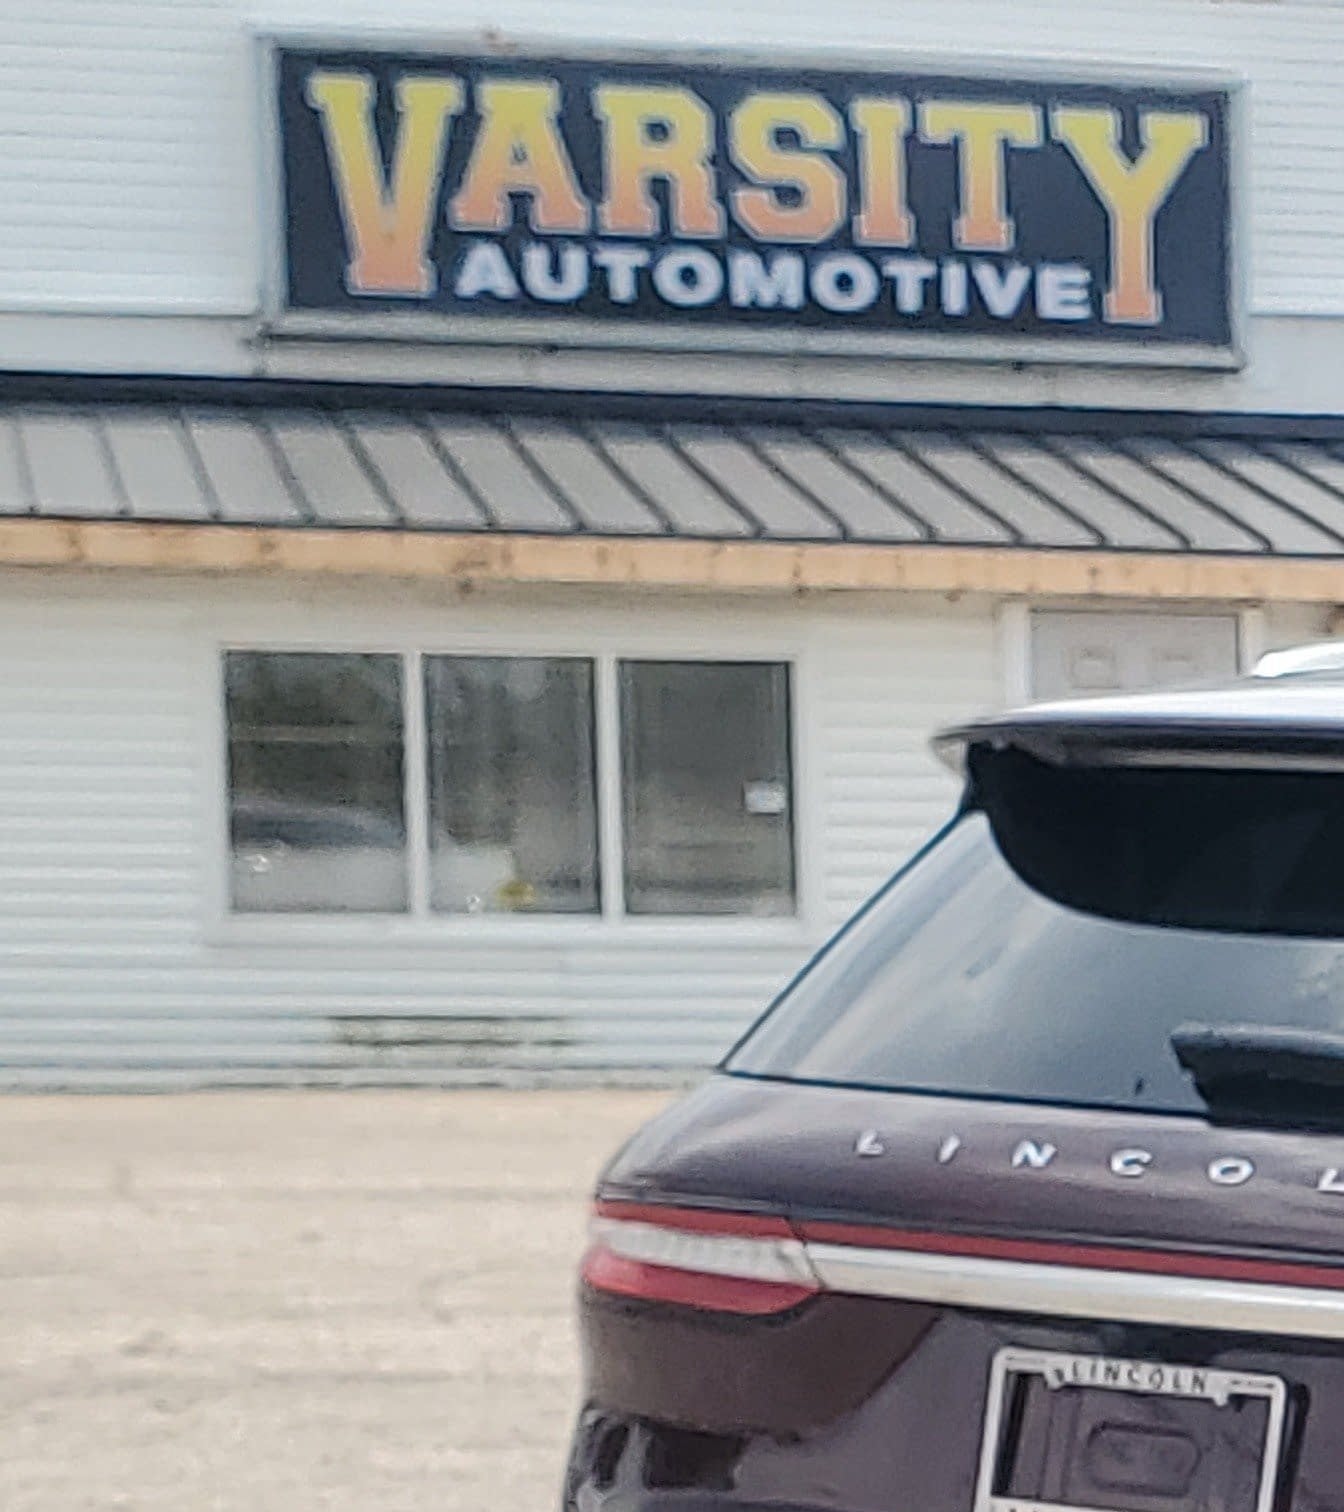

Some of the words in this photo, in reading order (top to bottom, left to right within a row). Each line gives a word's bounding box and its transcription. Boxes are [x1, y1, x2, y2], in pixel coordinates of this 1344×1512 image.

[305, 70, 1209, 327] VARSITY
[454, 239, 1092, 321] AUTOMOTIVE
[1071, 1360, 1210, 1393] LINCOLN
